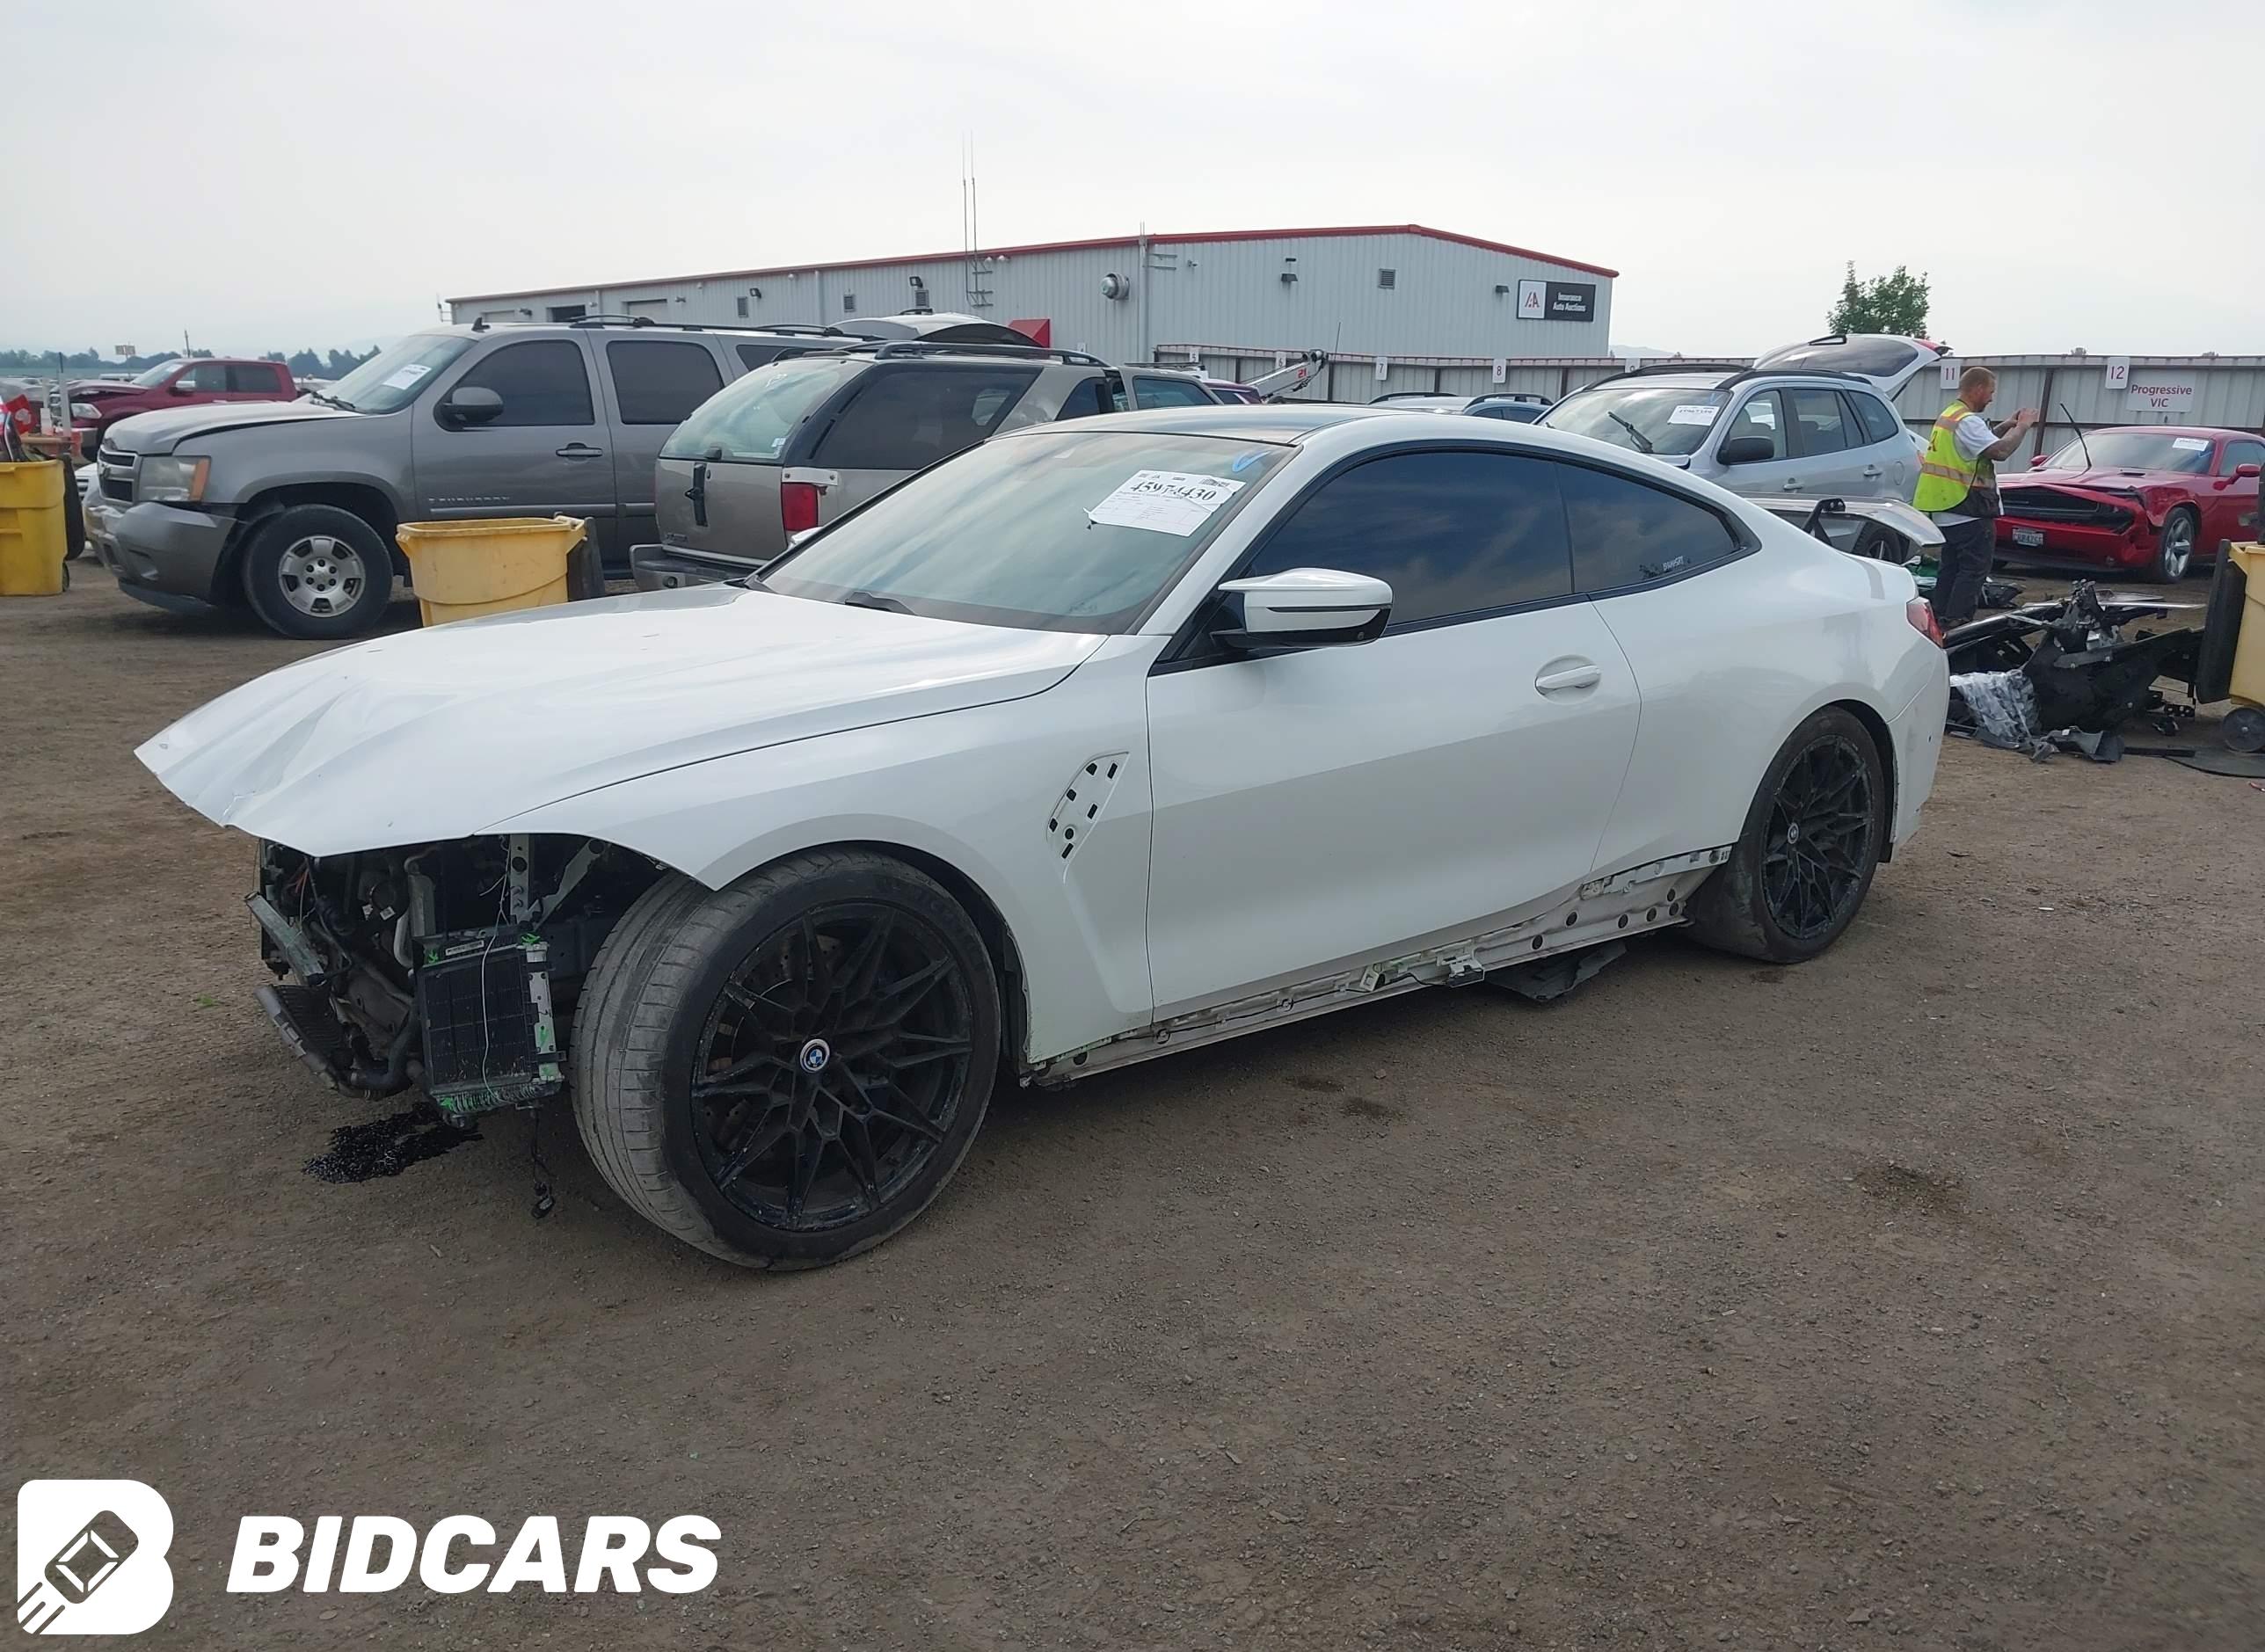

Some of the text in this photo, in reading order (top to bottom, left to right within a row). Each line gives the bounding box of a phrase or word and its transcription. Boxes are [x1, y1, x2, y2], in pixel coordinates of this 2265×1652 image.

[1379, 363, 1384, 374] 7
[1497, 365, 1502, 376] 8
[2110, 366, 2125, 380] 12
[1945, 368, 1955, 381] 11
[2130, 384, 2192, 396] Progressive
[2151, 398, 2169, 407] VIC
